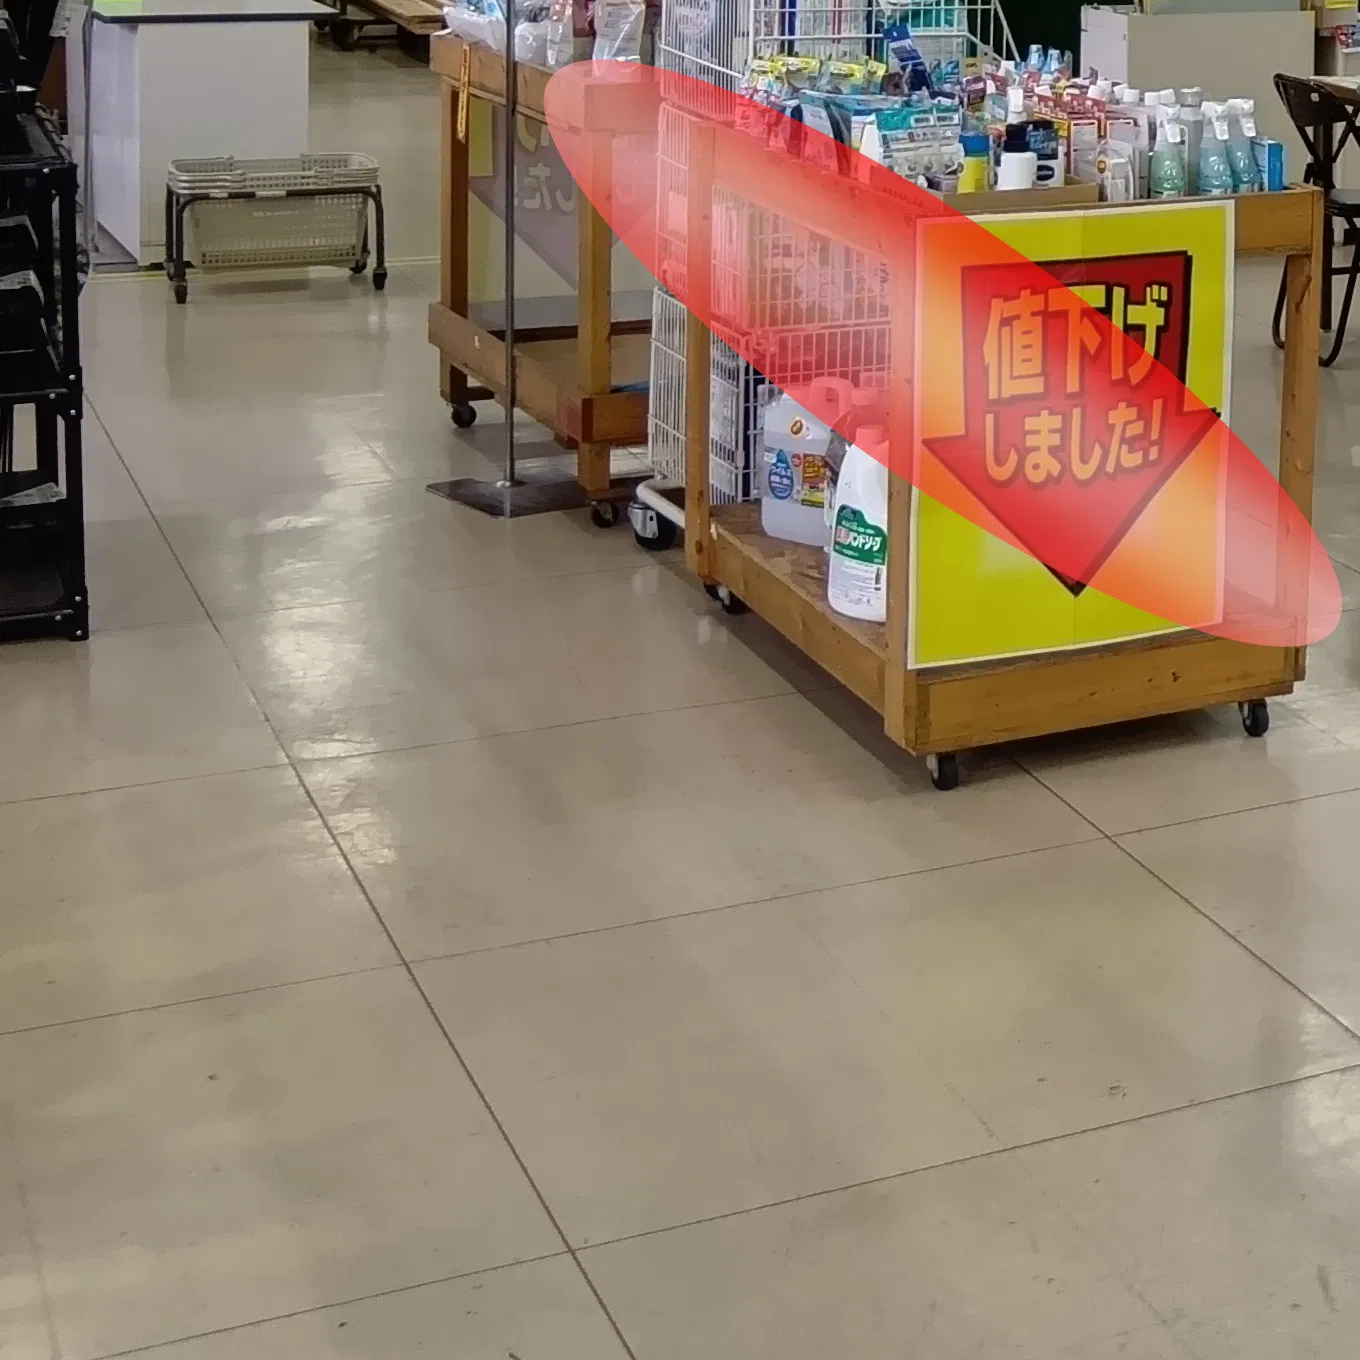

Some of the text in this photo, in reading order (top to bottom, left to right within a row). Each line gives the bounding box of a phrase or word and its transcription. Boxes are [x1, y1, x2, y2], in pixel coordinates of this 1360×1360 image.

[981, 282, 1169, 402] 値下げ
[981, 397, 1166, 485] しました!
